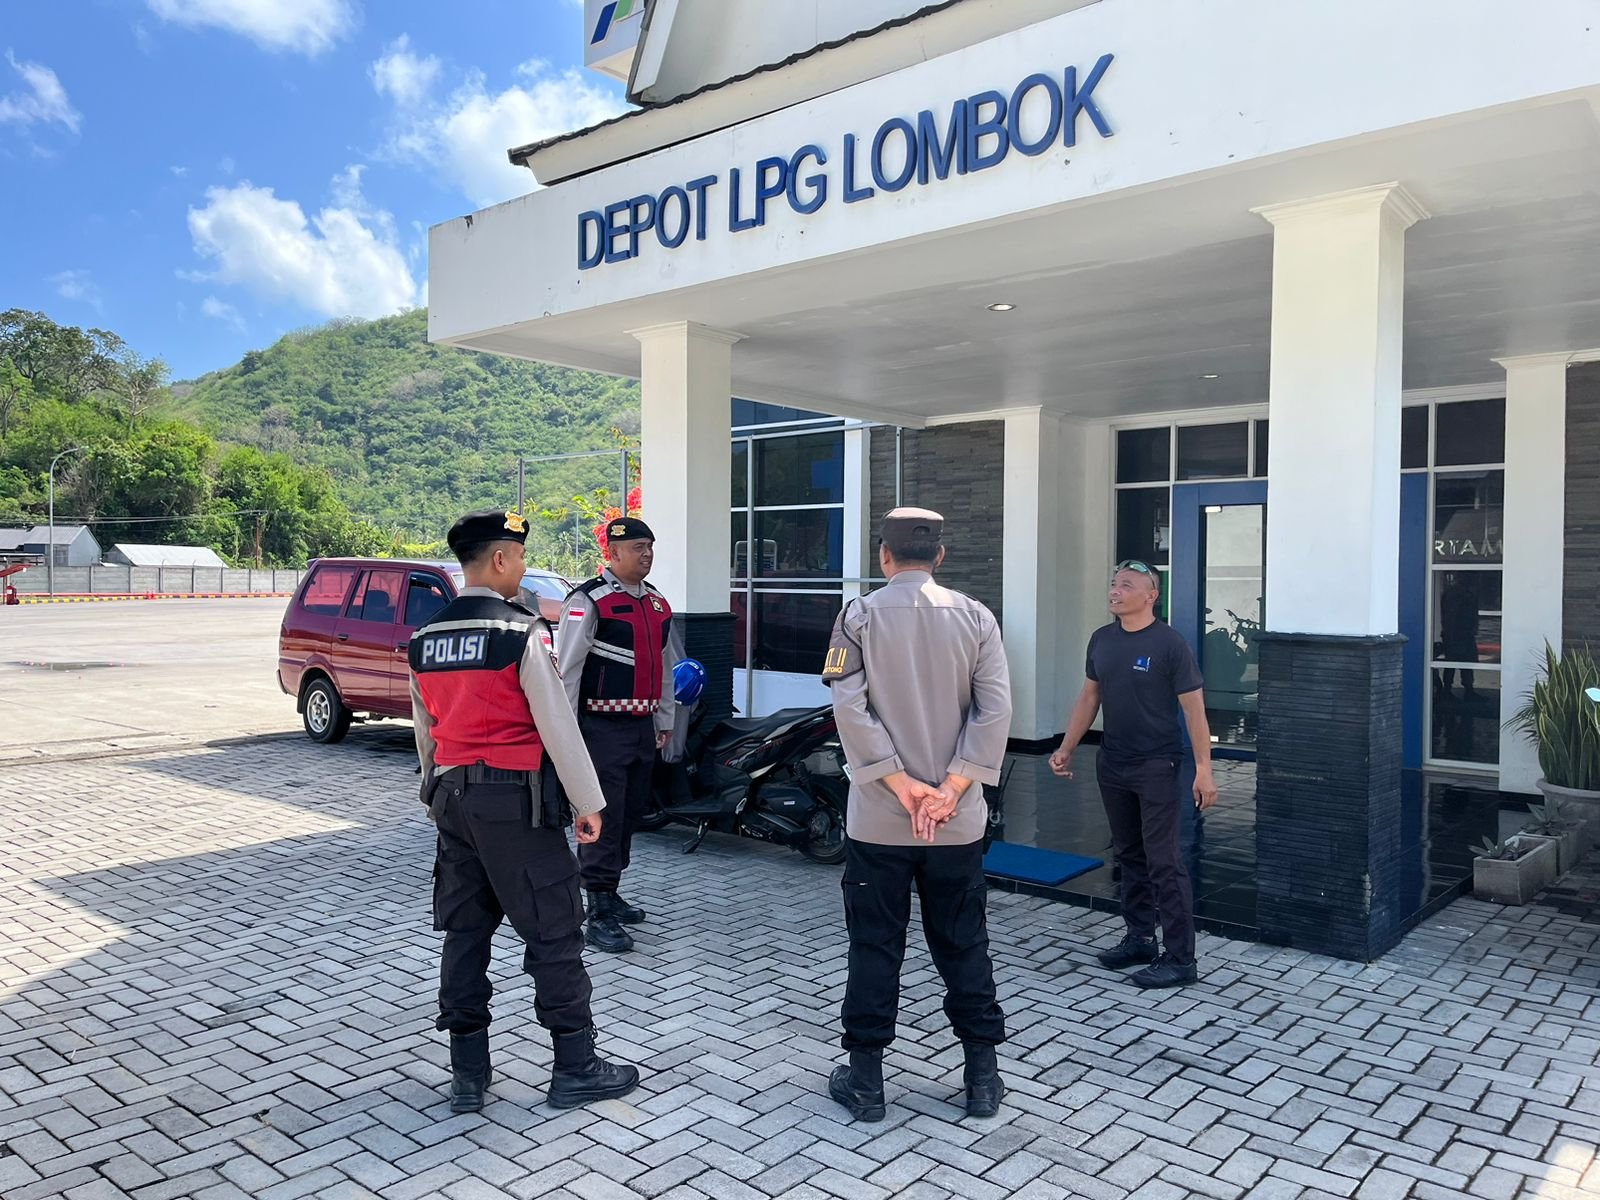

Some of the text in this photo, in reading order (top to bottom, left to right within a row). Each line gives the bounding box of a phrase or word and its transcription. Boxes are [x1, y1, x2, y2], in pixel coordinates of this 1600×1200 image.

[577, 53, 1115, 271] DEPOT LPG LOMBOK
[422, 635, 485, 665] POLISI
